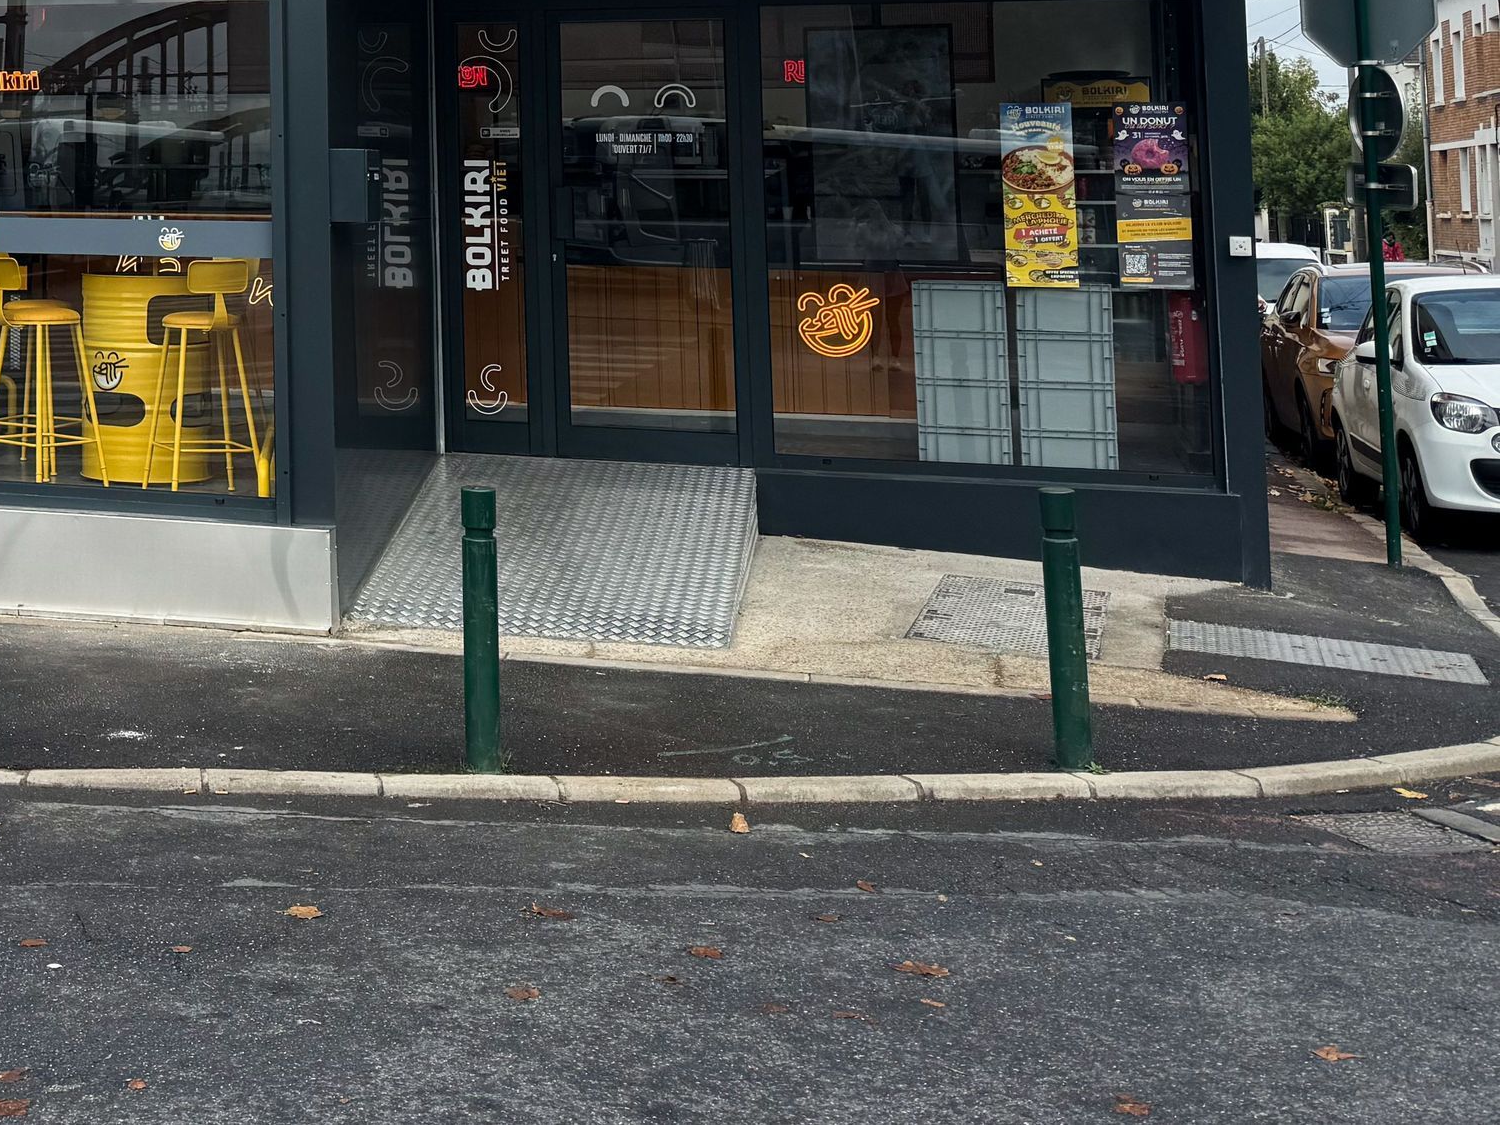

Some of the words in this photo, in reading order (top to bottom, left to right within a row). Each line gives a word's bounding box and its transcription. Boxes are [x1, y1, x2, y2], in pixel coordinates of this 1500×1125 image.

[1082, 86, 1127, 95] BOLKIRI
[1025, 106, 1065, 114] BOLKIRI
[1122, 117, 1138, 125] UN
[1140, 117, 1177, 125] DONUT
[595, 133, 614, 143] LUNDI
[620, 133, 653, 143] DIMANCHE
[613, 144, 637, 154] OUVERT
[499, 198, 509, 233] FOOD
[463, 160, 493, 291] BOLKIRI
